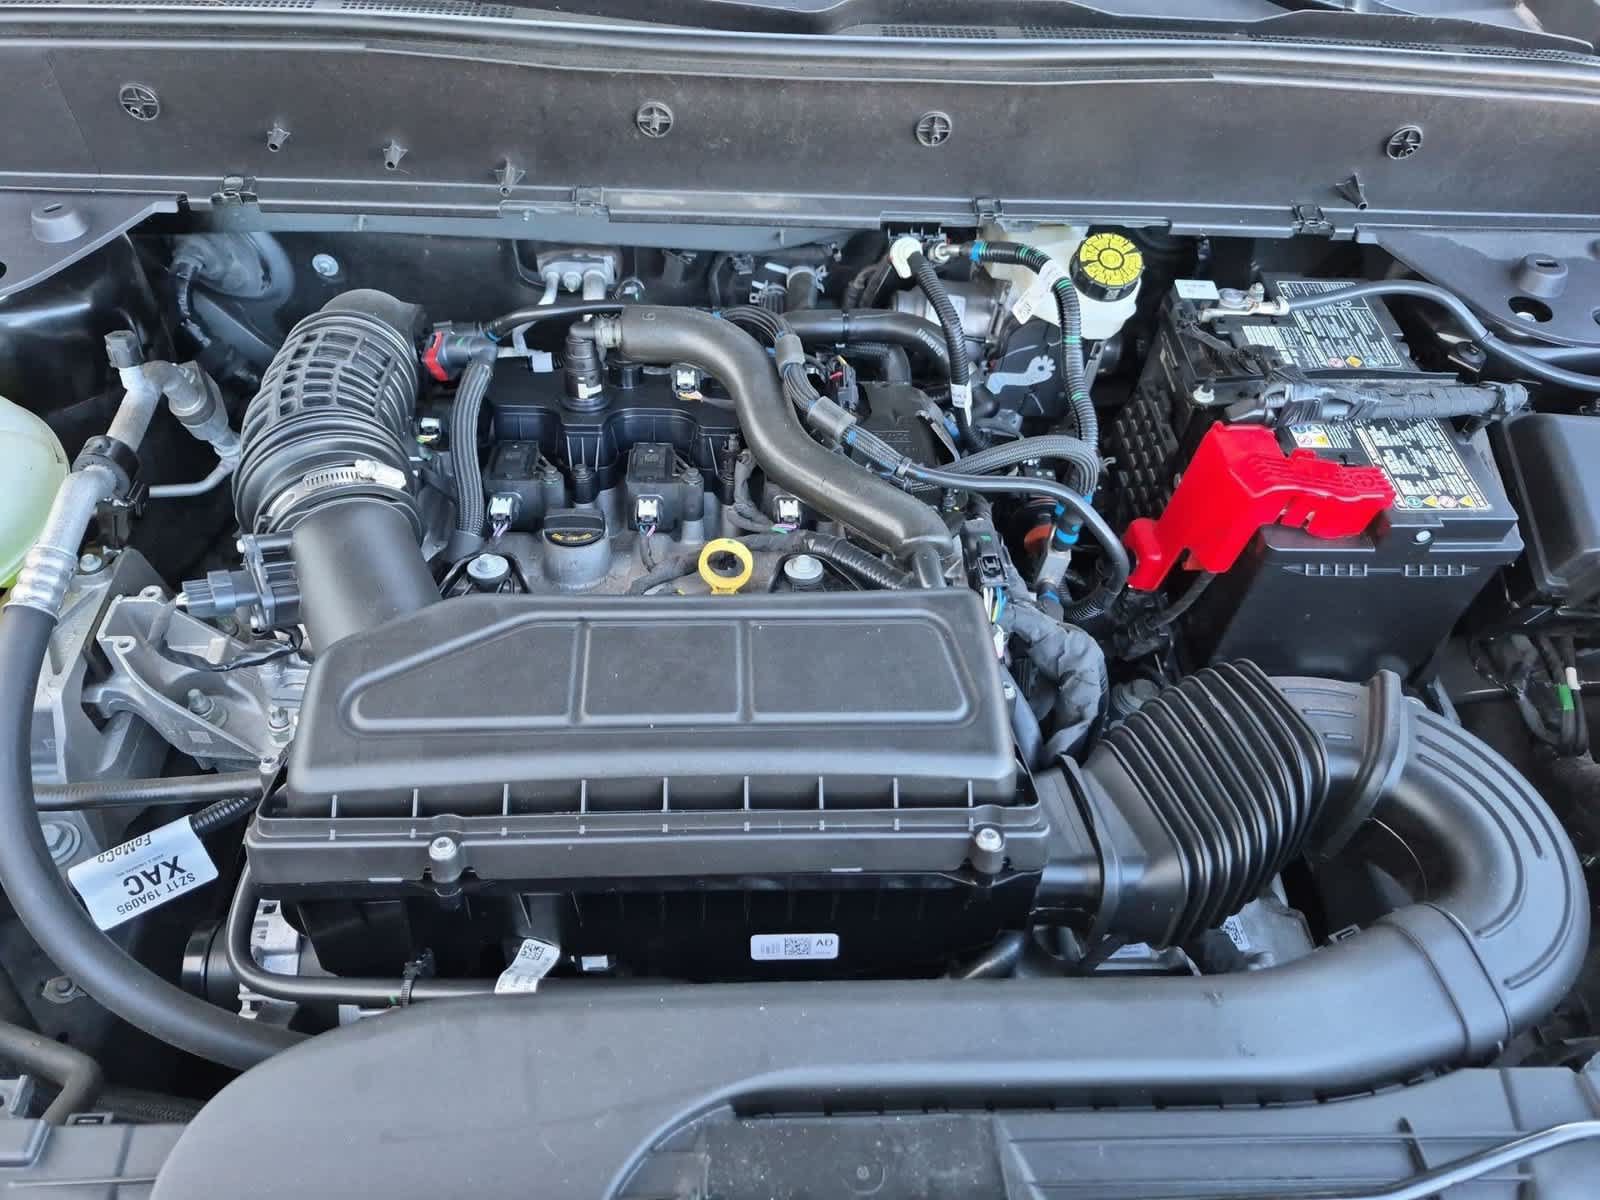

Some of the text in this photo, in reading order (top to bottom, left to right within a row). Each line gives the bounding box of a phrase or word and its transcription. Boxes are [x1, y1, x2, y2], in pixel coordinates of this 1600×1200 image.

[97, 834, 152, 863] FoMoCo
[123, 855, 187, 896] XAC
[116, 888, 162, 915] 19A095
